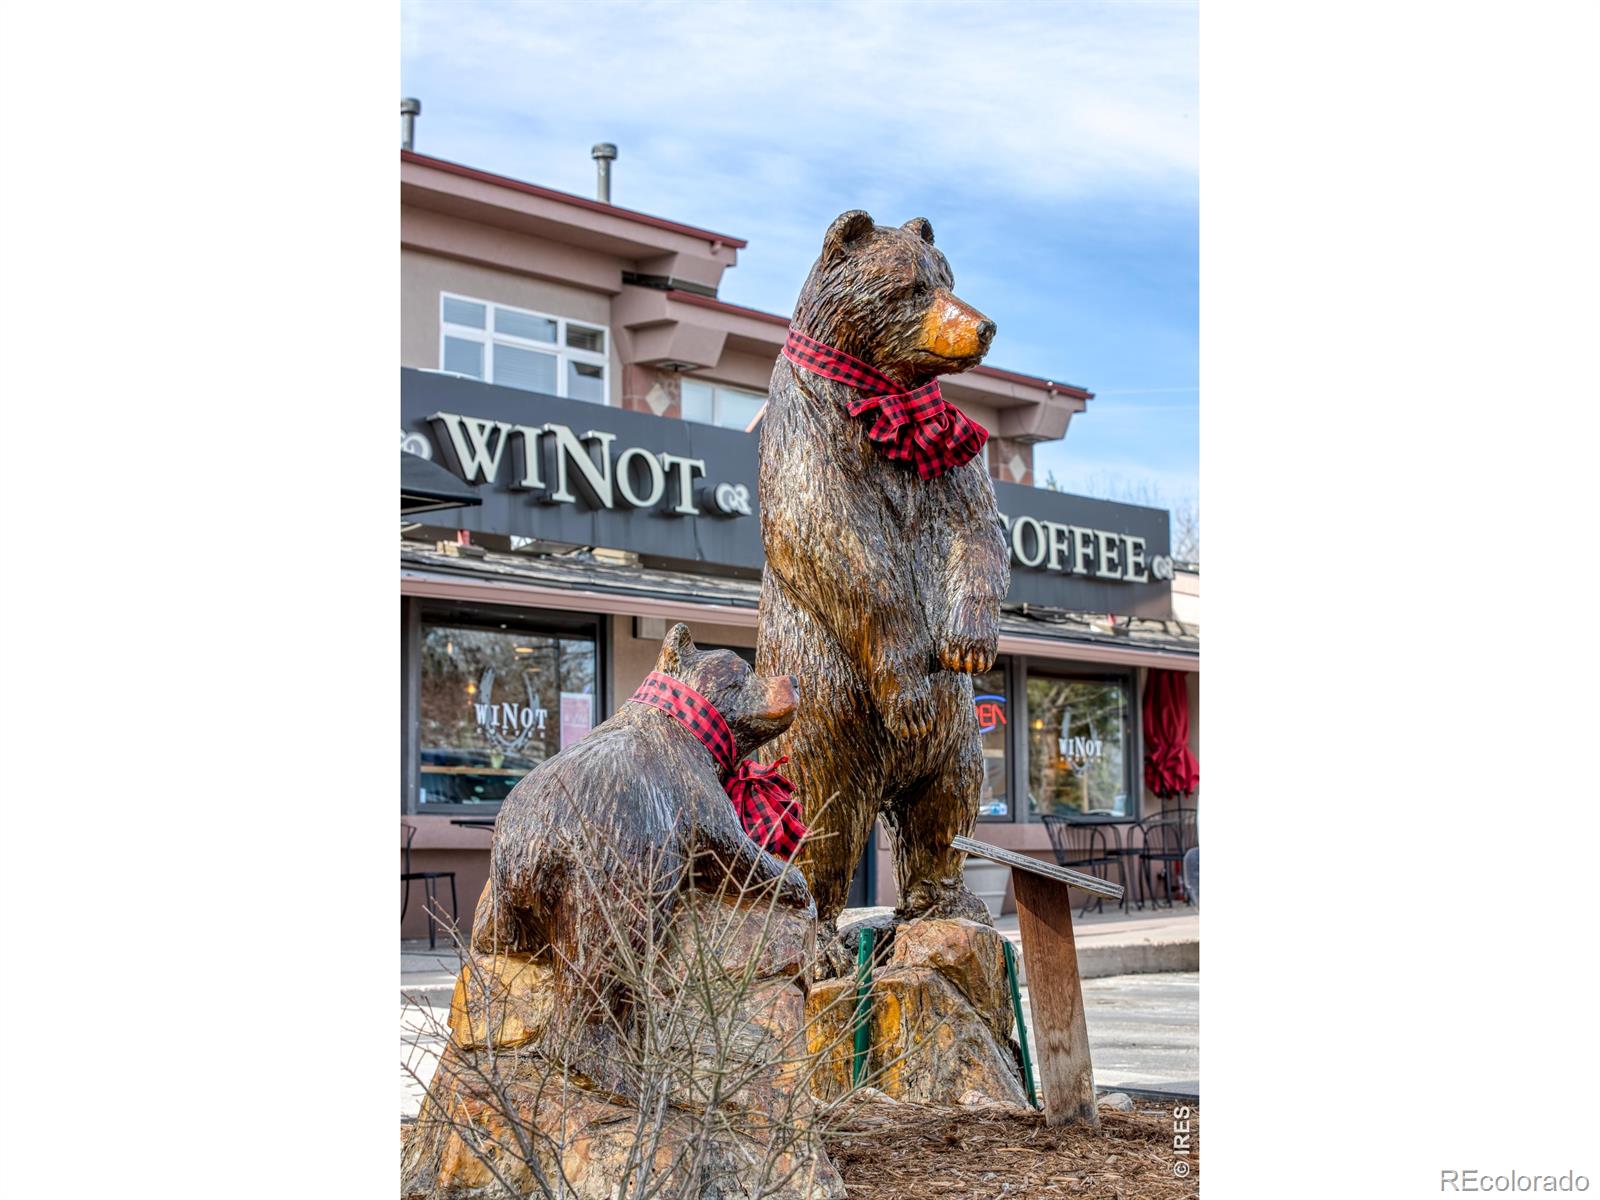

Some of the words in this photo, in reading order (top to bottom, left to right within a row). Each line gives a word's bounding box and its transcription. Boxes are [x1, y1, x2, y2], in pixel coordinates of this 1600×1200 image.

[427, 411, 706, 516] WINOT
[998, 511, 1149, 584] OFFEE
[474, 702, 548, 731] WINOT
[976, 703, 1008, 728] EN
